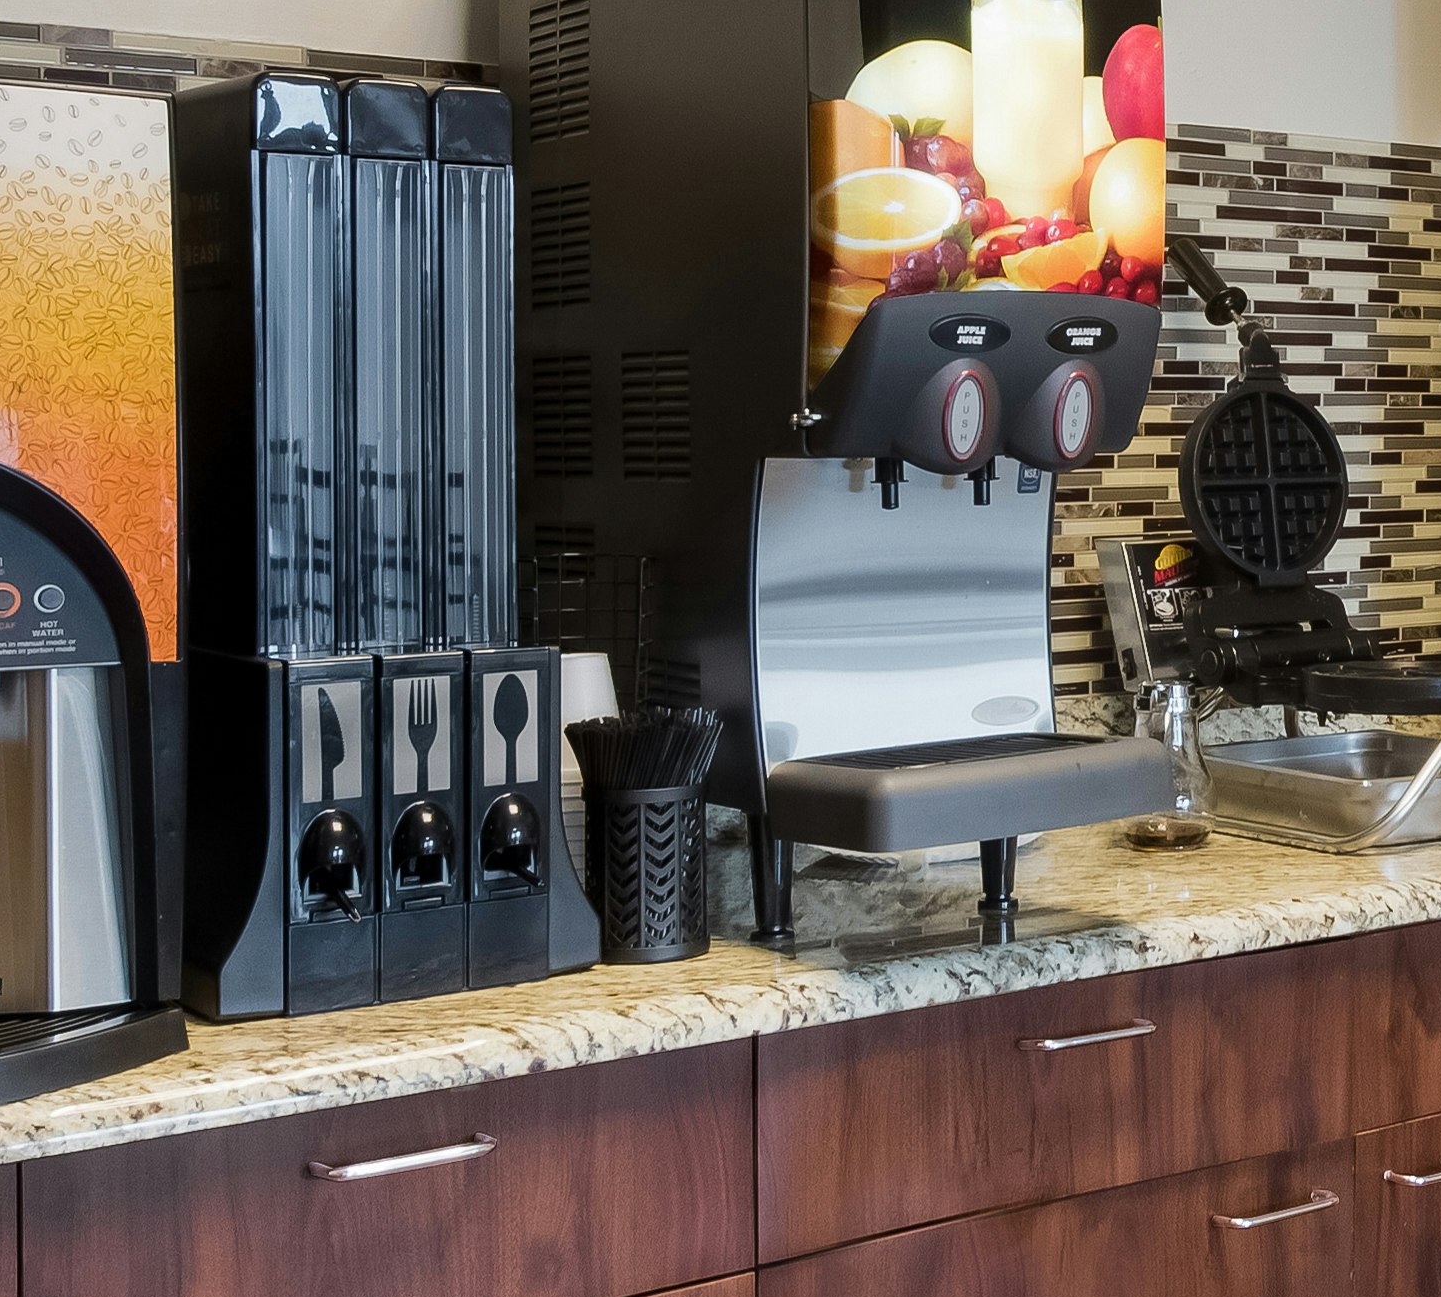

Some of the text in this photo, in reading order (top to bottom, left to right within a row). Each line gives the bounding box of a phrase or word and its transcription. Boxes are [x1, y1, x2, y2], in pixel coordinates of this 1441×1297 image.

[957, 325, 986, 335] APPLE
[1066, 327, 1102, 337] ORANGE
[957, 336, 983, 345] JUICE
[1071, 337, 1094, 346] JUICE
[960, 392, 971, 441] PUSH
[1069, 392, 1080, 441] PUSH
[39, 620, 58, 628] HOT
[31, 628, 64, 637] WATER
